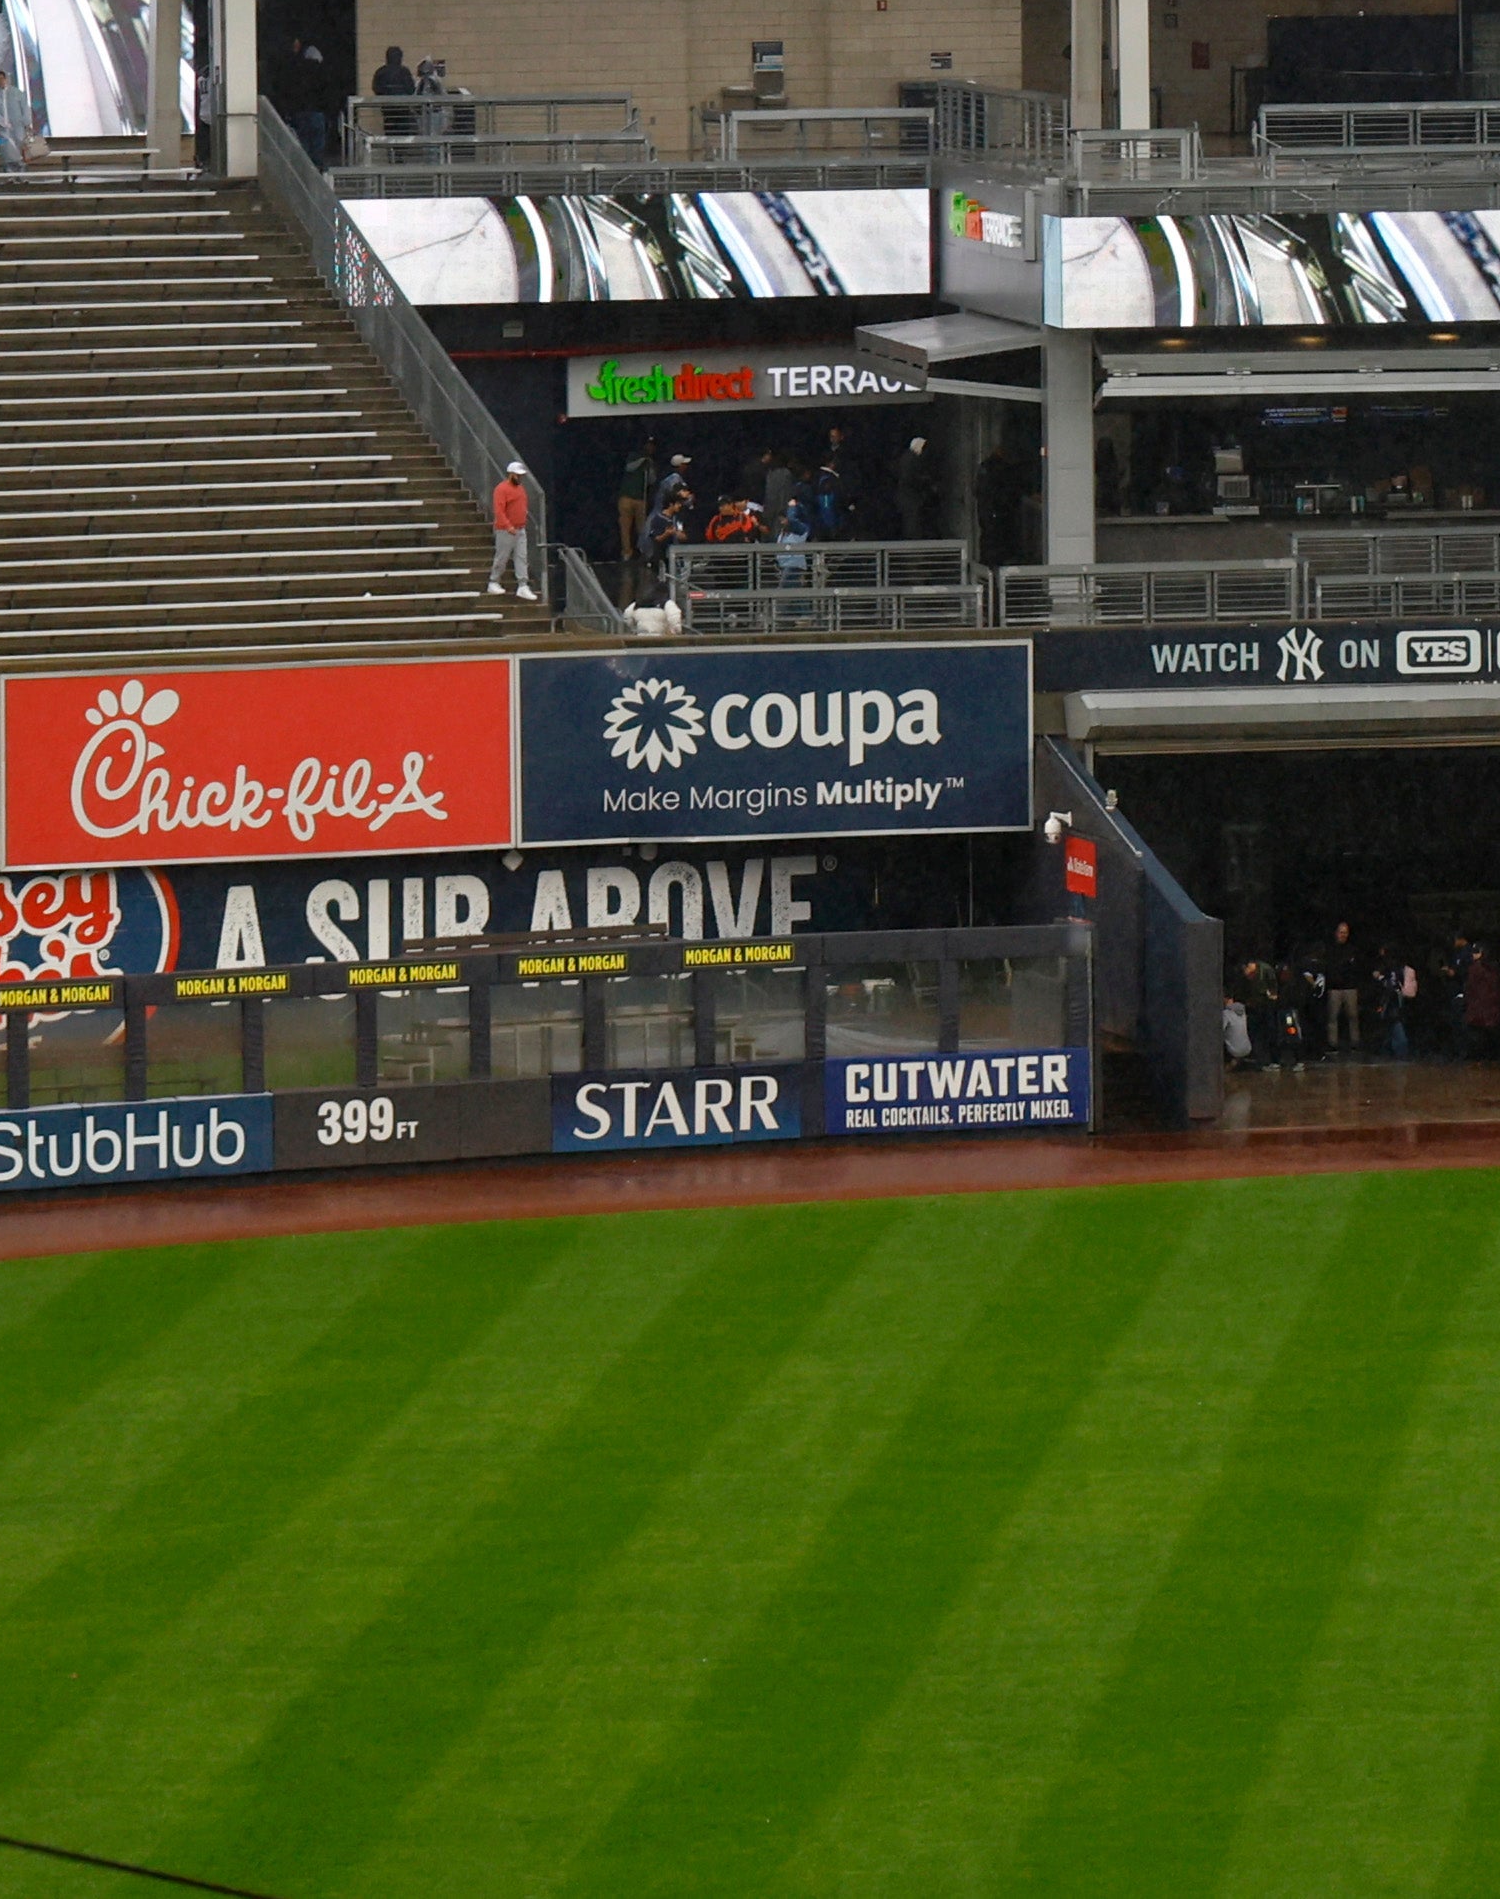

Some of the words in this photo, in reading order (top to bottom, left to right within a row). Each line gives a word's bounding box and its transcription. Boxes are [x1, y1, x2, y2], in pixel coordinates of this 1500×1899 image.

[767, 364, 921, 398] TERRAC
[1151, 642, 1260, 673] WATCH
[1339, 639, 1381, 670] ON
[1410, 641, 1467, 663] YES
[710, 688, 942, 766] coupa
[70, 718, 448, 841] Chick-fil-A
[603, 786, 680, 812] Make
[689, 782, 807, 816] Margins
[519, 957, 564, 975] MORGAN
[568, 957, 576, 972] &
[578, 954, 624, 971] MORGAN
[845, 1054, 1069, 1102] CUTWATER
[318, 1097, 395, 1146] 399
[396, 1117, 417, 1141] FT
[574, 1075, 779, 1141] STARR
[846, 1108, 877, 1129] REAL
[882, 1105, 953, 1127] COCKTAILS.
[958, 1101, 1026, 1124] PERFECTLY
[1031, 1099, 1074, 1119] MIXED.
